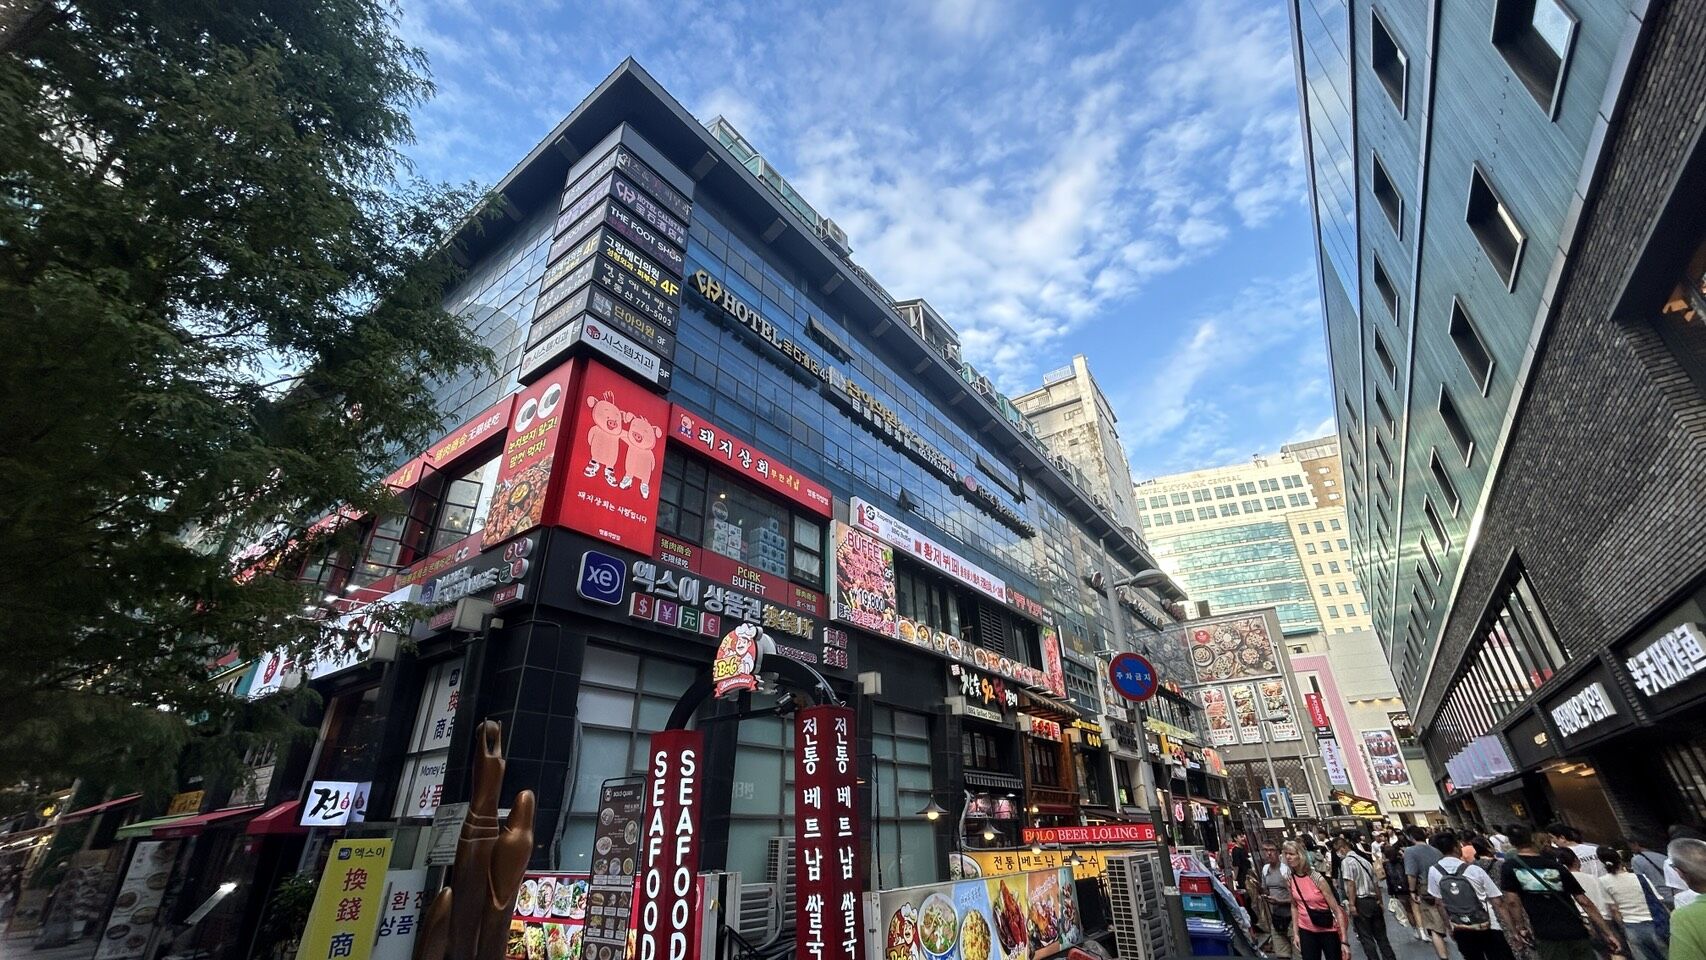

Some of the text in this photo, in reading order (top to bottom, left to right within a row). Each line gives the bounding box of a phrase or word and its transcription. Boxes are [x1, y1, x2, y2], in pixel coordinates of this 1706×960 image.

[610, 206, 629, 225] THE
[631, 221, 655, 244] FOOT
[657, 241, 682, 263] SHOP
[604, 234, 660, 281] 그랑메디의원
[660, 279, 680, 297] 4F
[602, 275, 633, 302] 부동산
[635, 297, 672, 327] 779-5003
[722, 289, 783, 350] HOTEL
[614, 304, 656, 341] 단아의원
[656, 335, 667, 346] 3F
[602, 333, 655, 371] 시스템치과
[659, 368, 671, 380] 3F
[507, 431, 536, 454] 눈치보지
[698, 427, 770, 479] 돼지상회
[1163, 480, 1207, 494] SKYPARK
[1207, 475, 1243, 486] CENTRAL
[617, 505, 648, 524] 사랑입니다
[847, 532, 884, 561] BUFFET
[923, 542, 960, 577] 황제뷔페
[587, 566, 613, 588] xe
[632, 560, 701, 607] 엑스이
[703, 584, 763, 628] 상품권
[731, 576, 767, 597] BUFFET
[684, 611, 696, 627] 元
[1116, 671, 1152, 682] 주차금지
[803, 717, 821, 776] 전통
[835, 717, 850, 775] 전통
[1388, 792, 1414, 800] WITH
[354, 847, 386, 858] 엑스이
[803, 785, 824, 882] 베트남
[837, 785, 853, 881] 베트남
[1024, 829, 1056, 842] BOLO
[1058, 828, 1089, 841] BEER
[1092, 826, 1139, 841] LOLING
[643, 751, 668, 960] SEAFOOD
[670, 750, 696, 960] SEAFOOD
[993, 856, 1016, 872] 전통
[1020, 853, 1056, 868] 베트남
